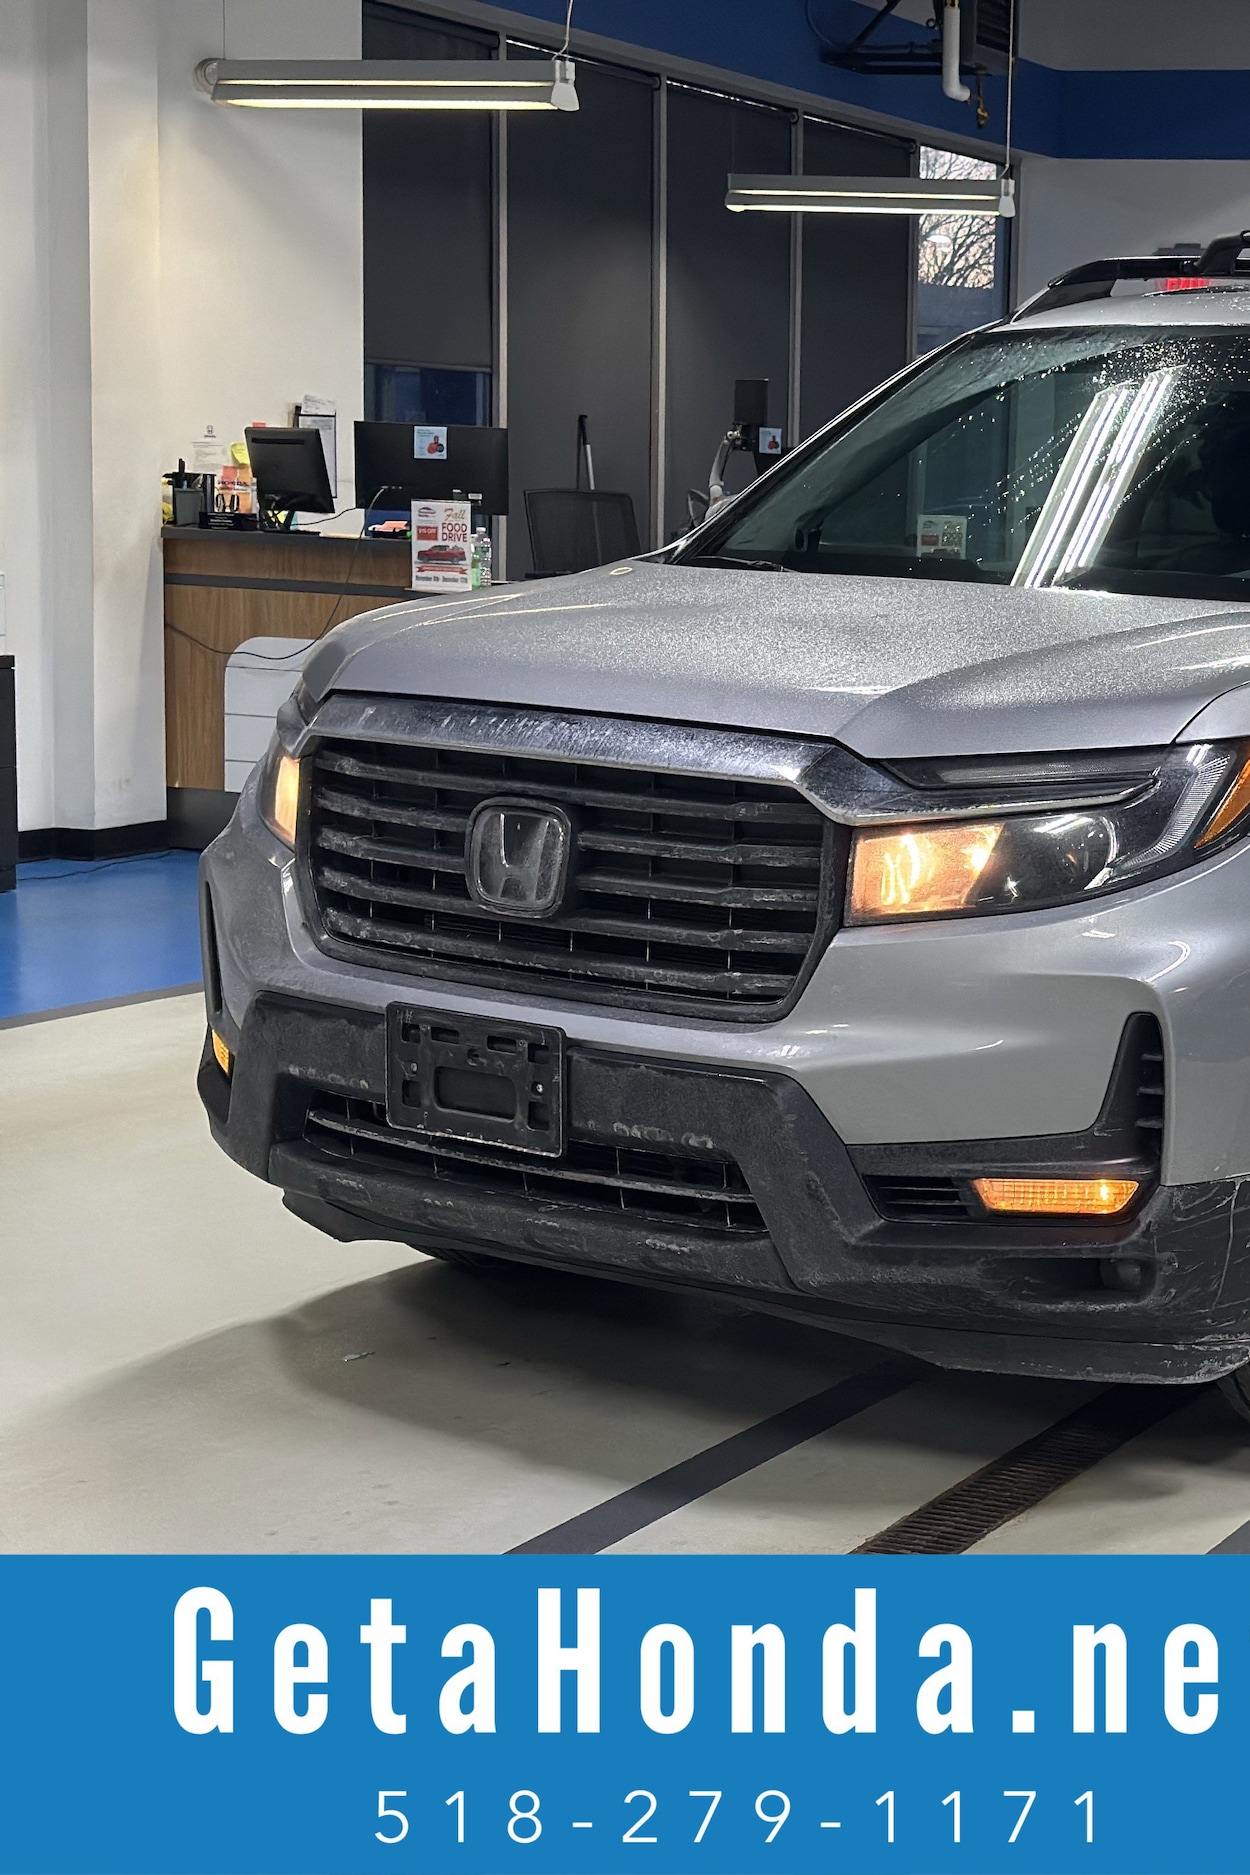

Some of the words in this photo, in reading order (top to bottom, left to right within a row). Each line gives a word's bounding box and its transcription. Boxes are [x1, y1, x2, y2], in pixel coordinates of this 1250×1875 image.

[444, 508, 466, 521] Fall
[442, 522, 467, 533] FOOD
[442, 533, 467, 542] DRIVE
